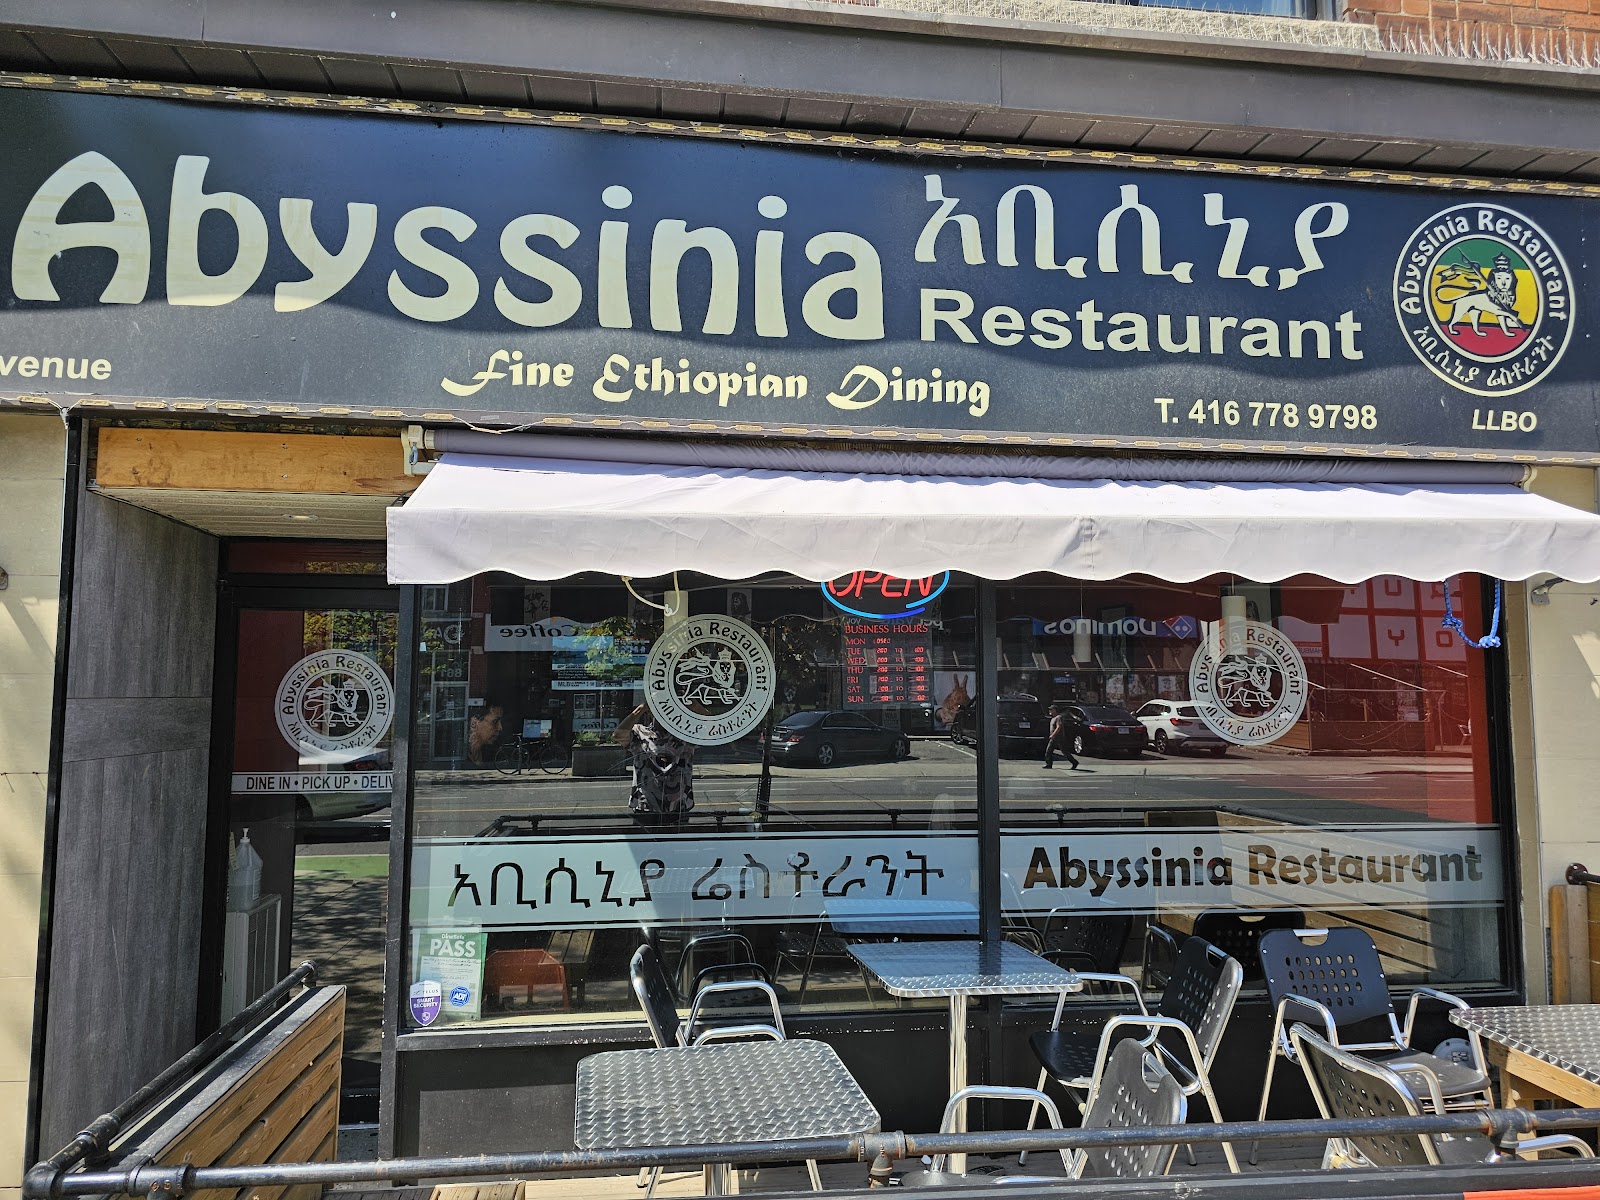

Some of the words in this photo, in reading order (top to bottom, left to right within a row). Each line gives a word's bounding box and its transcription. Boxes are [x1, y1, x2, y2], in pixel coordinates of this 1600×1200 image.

[11, 151, 885, 341] Abyssinia
[915, 174, 1349, 290] አቢሲኒያ
[1400, 216, 1470, 315] Abyssinia
[1478, 210, 1566, 321] Restaurant
[919, 289, 1364, 361] Restaurant
[440, 349, 574, 397] Fine
[592, 353, 808, 407] Ethiopian
[825, 365, 991, 417] Dining
[1154, 398, 1179, 423] T.
[1189, 399, 1240, 425] 416
[1248, 401, 1300, 428] 778
[1308, 404, 1378, 429] 9798
[1472, 409, 1538, 432] LLBO
[845, 624, 890, 634] BUSINESS
[893, 624, 929, 633] HOURS
[847, 647, 861, 655] TUE
[710, 622, 767, 691] Restaurant
[847, 657, 865, 665] WED
[847, 666, 864, 674] THU
[1247, 628, 1301, 696] Restaurant
[282, 659, 329, 715] Abyssinia
[336, 655, 387, 716] Restaurant
[847, 695, 864, 703] SUN
[246, 777, 275, 789] DINE
[279, 776, 291, 789] IN
[302, 776, 330, 789] PICK
[334, 776, 351, 788] UP
[448, 857, 665, 909] አቢሲኒያ
[692, 850, 945, 902] ሬስቶራንት
[1023, 846, 1233, 897] Abyssinia
[1248, 844, 1483, 886] Restaurant
[430, 939, 476, 957] PASS
